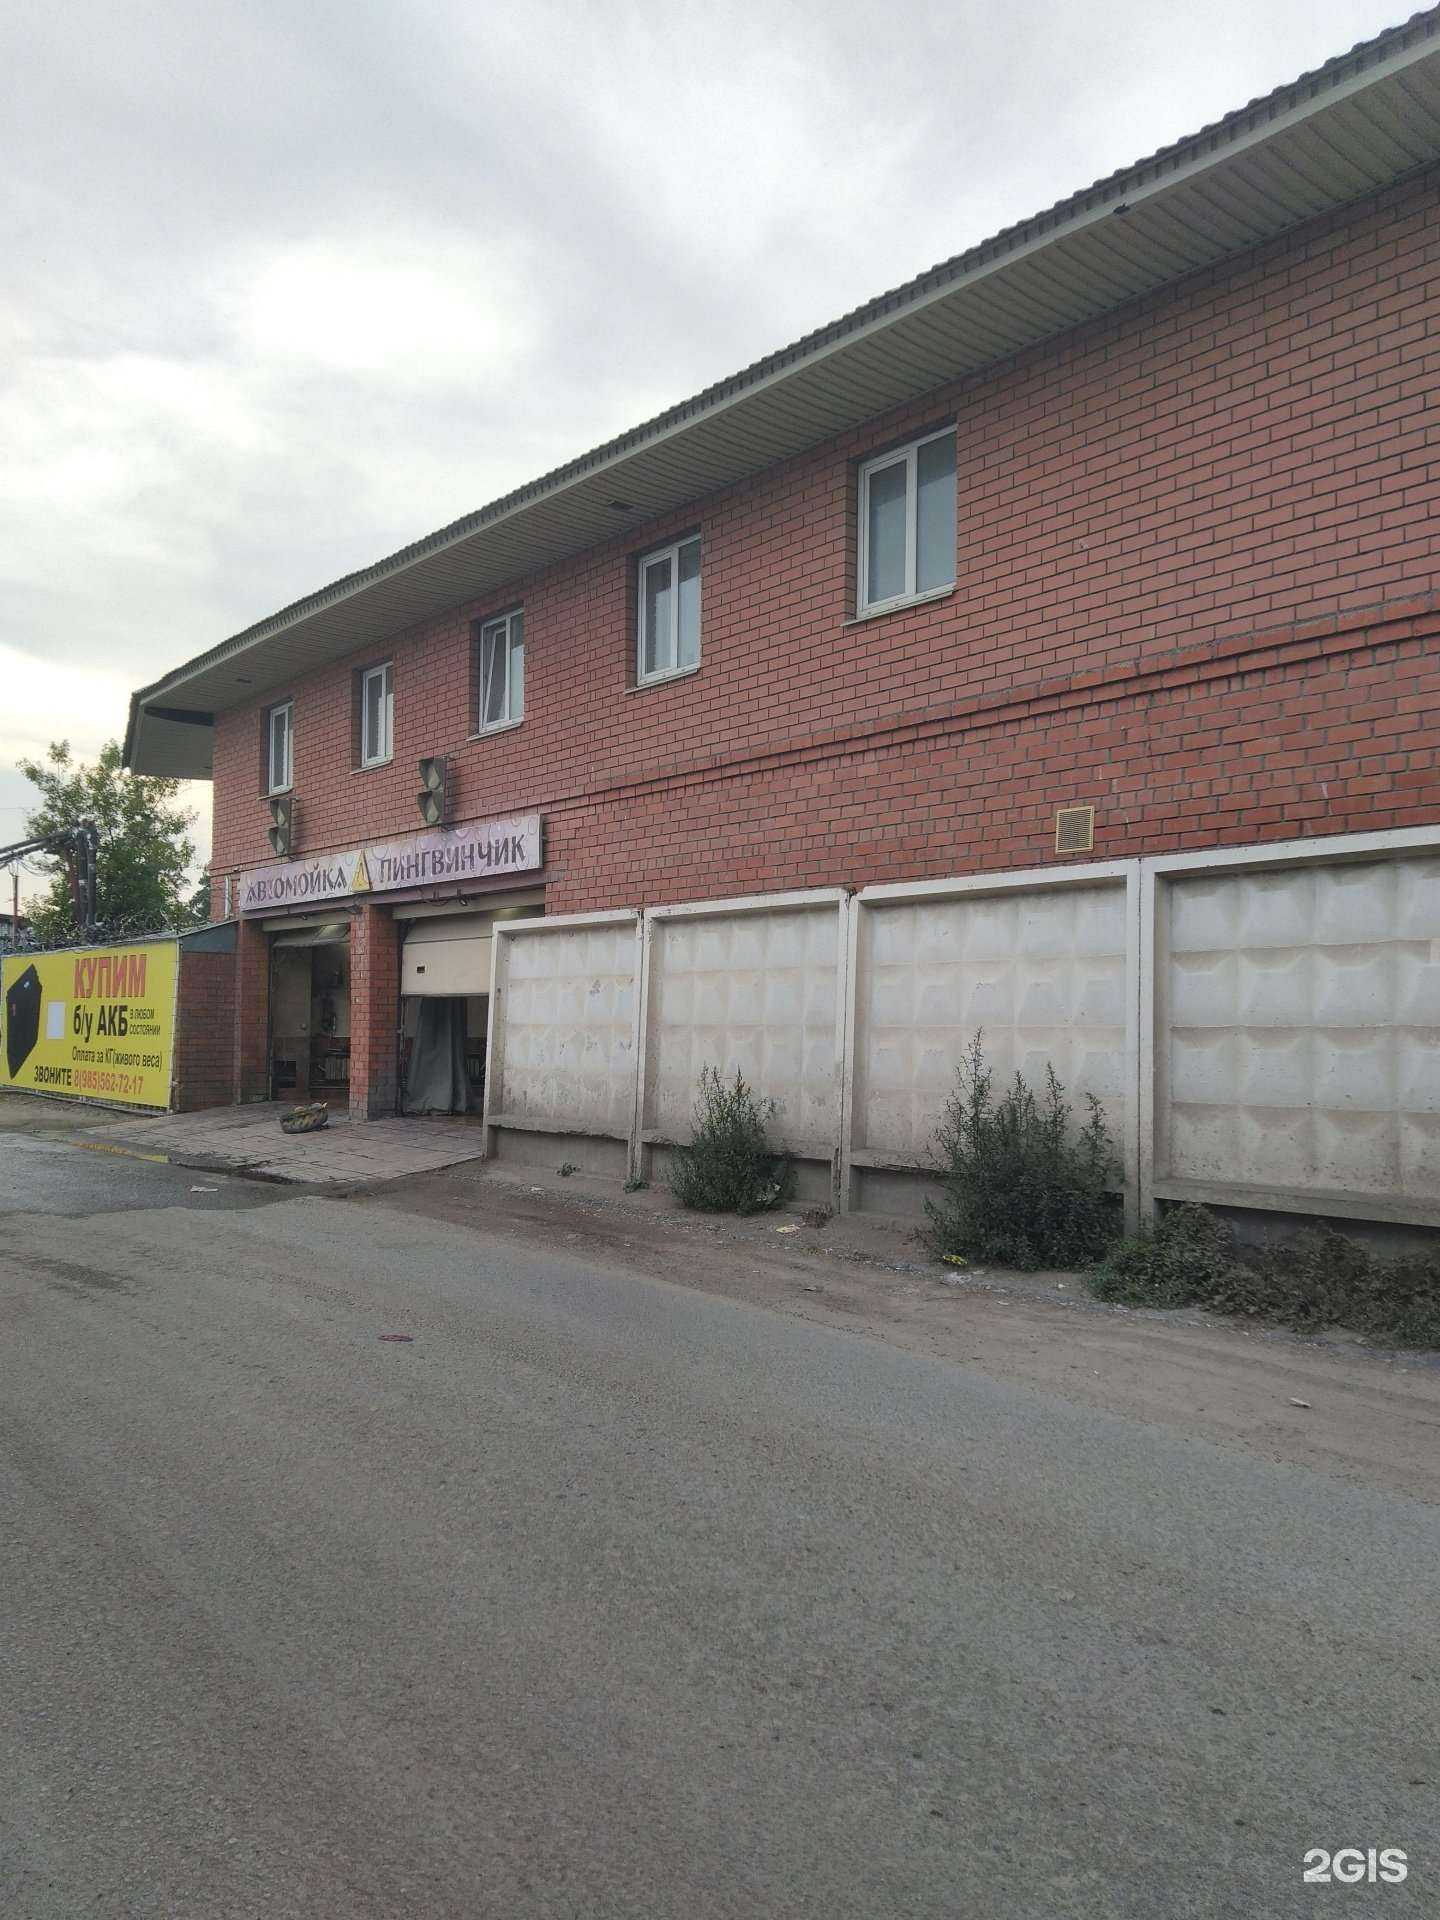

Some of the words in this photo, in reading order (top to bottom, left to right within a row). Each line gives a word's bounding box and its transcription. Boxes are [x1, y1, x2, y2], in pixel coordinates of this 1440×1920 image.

[380, 834, 526, 883] ПИНГВИНЧИК
[74, 954, 147, 997] КУПИМ
[73, 1005, 93, 1042] б/у
[97, 1005, 128, 1036] АКБ
[34, 1065, 72, 1086] ЗВОНИТЕ
[72, 1046, 95, 1062] Оплата
[96, 1052, 103, 1063] за
[142, 1053, 162, 1072] веса)
